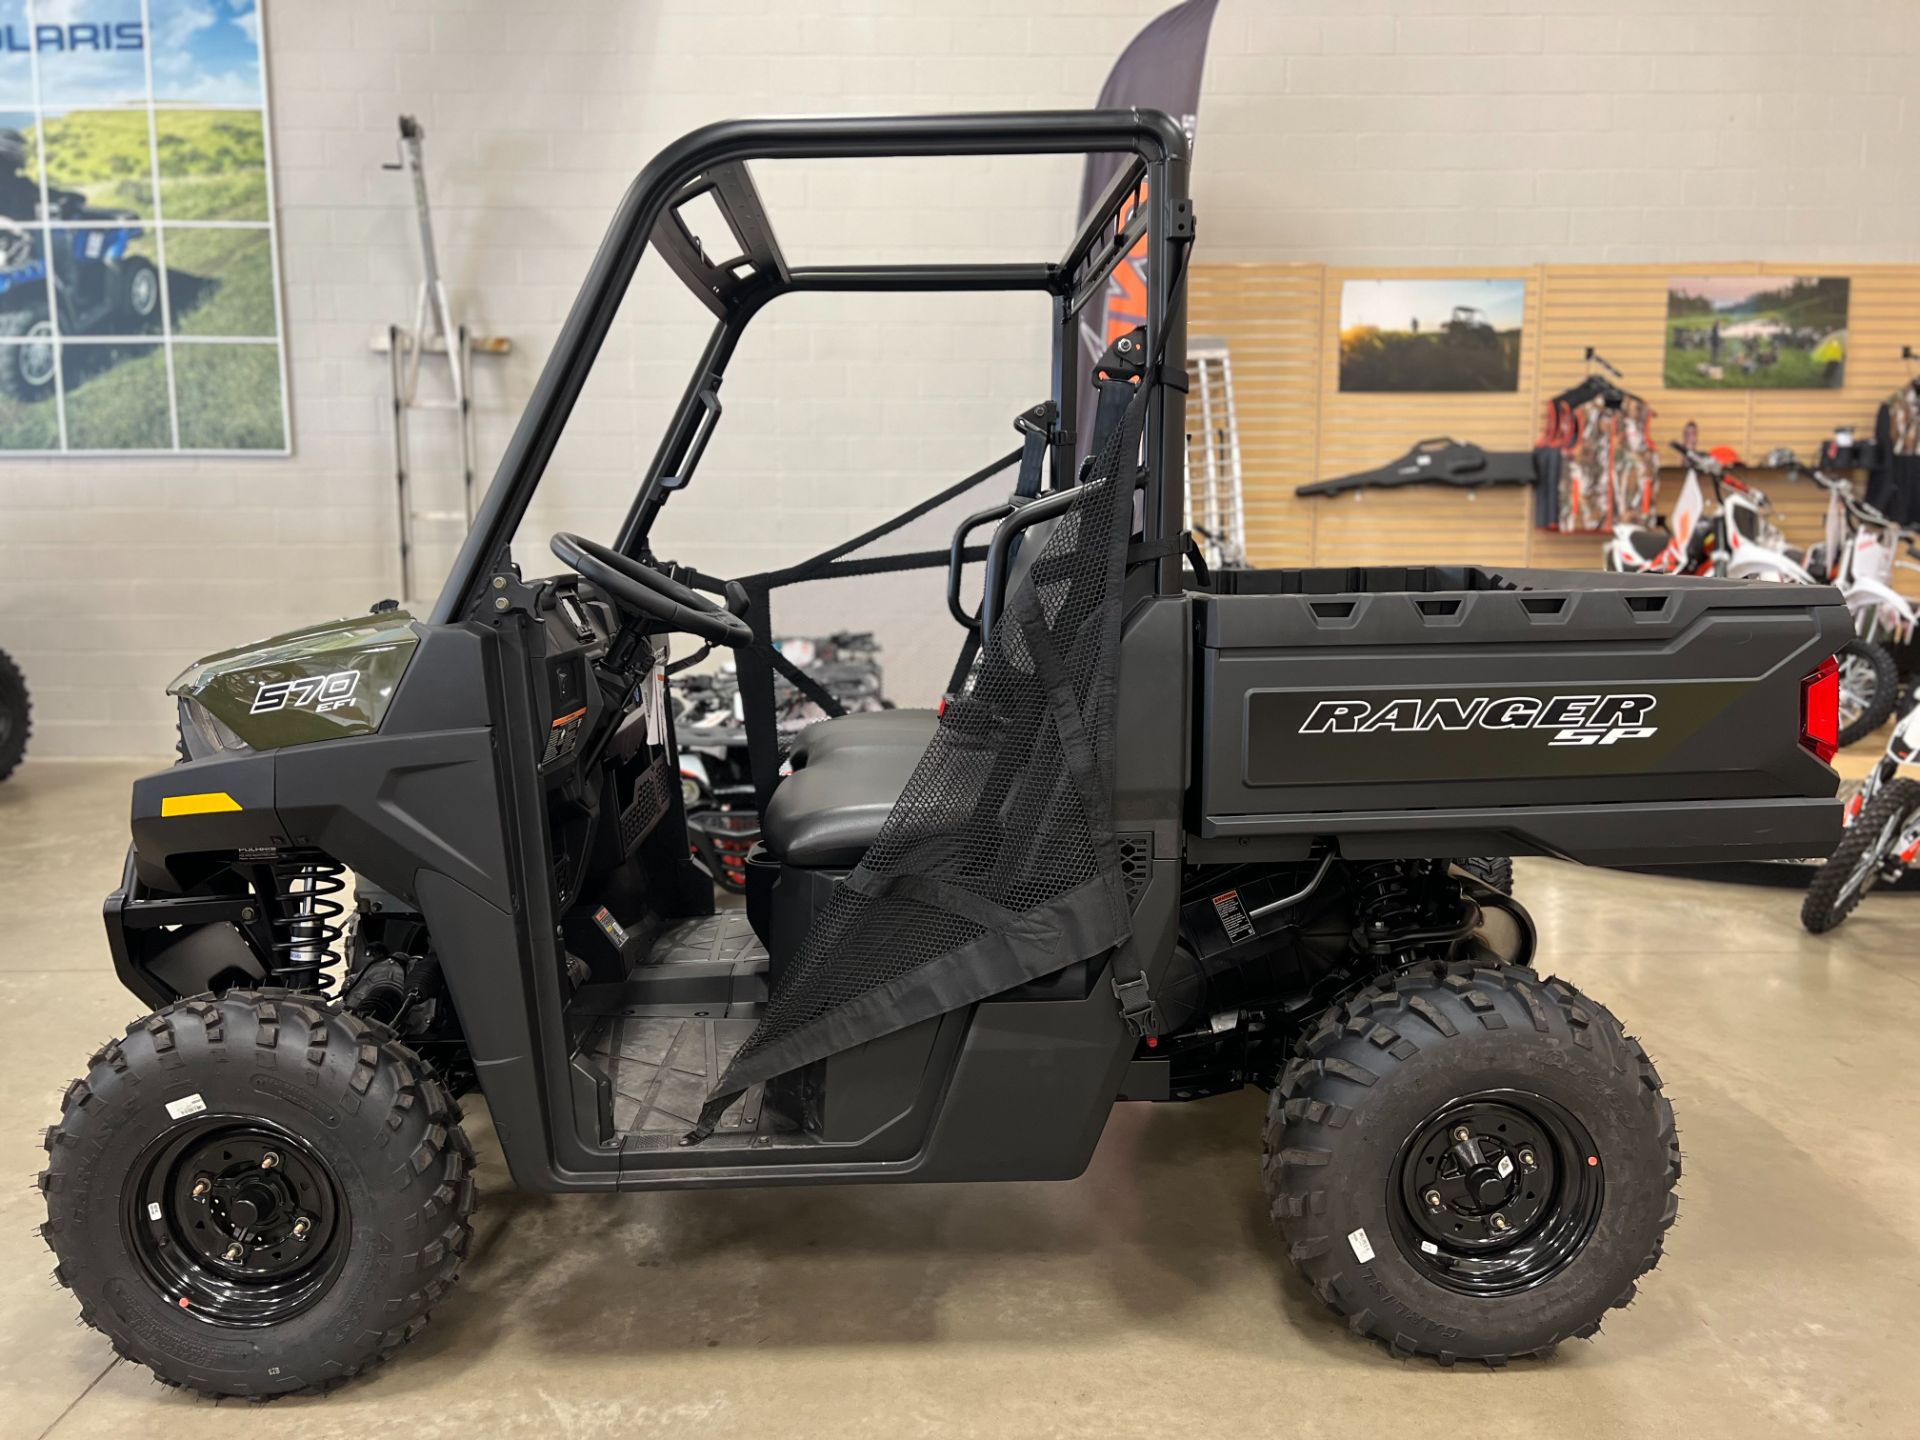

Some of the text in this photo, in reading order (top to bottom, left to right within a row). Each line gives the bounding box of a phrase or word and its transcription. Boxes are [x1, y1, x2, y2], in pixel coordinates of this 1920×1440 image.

[0, 22, 149, 52] LARIS
[250, 669, 360, 714] 570
[315, 697, 356, 713] EFI
[1298, 693, 1657, 734] RANGER
[1547, 727, 1658, 746] SP
